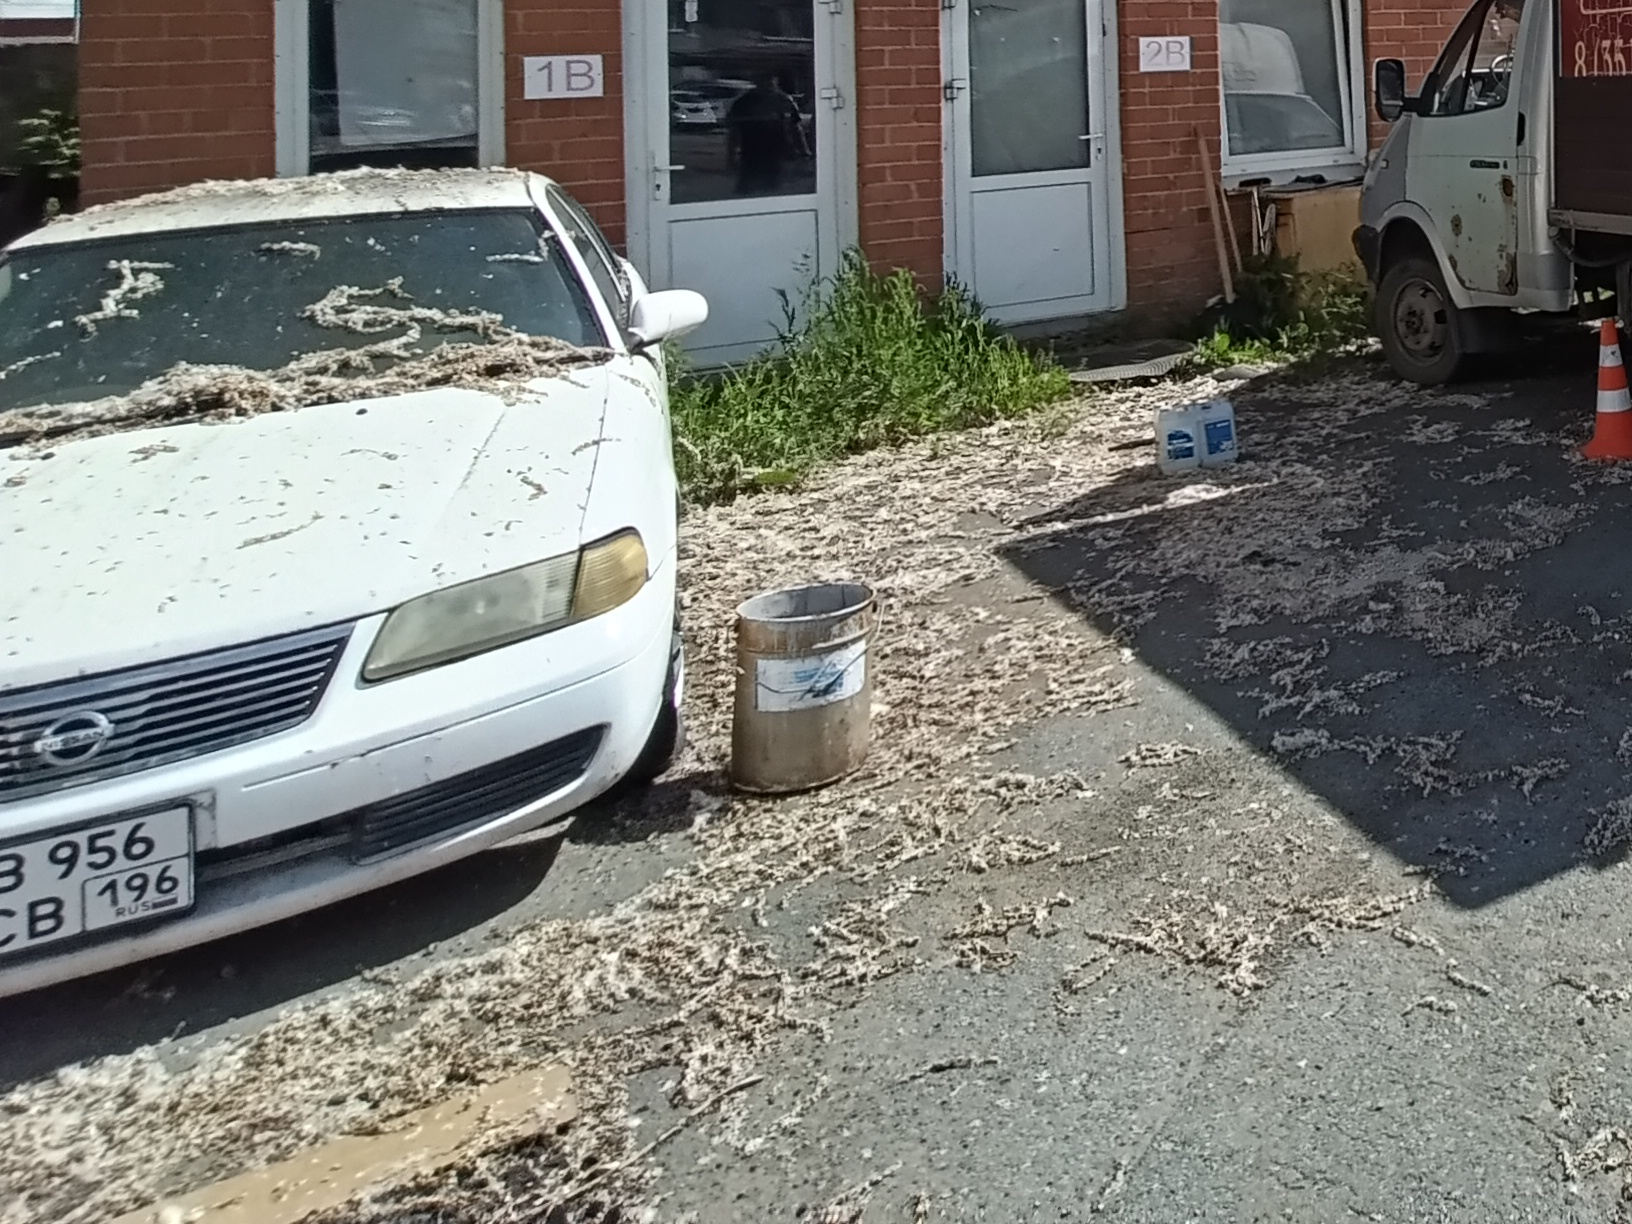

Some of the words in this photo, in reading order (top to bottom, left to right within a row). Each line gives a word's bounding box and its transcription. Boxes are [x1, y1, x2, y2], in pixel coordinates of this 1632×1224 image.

[1146, 41, 1185, 66] 2В
[1574, 41, 1586, 77] 8
[537, 60, 595, 92] 1В
[48, 822, 155, 880] 956
[97, 865, 179, 907] 196
[115, 901, 152, 917] RUS
